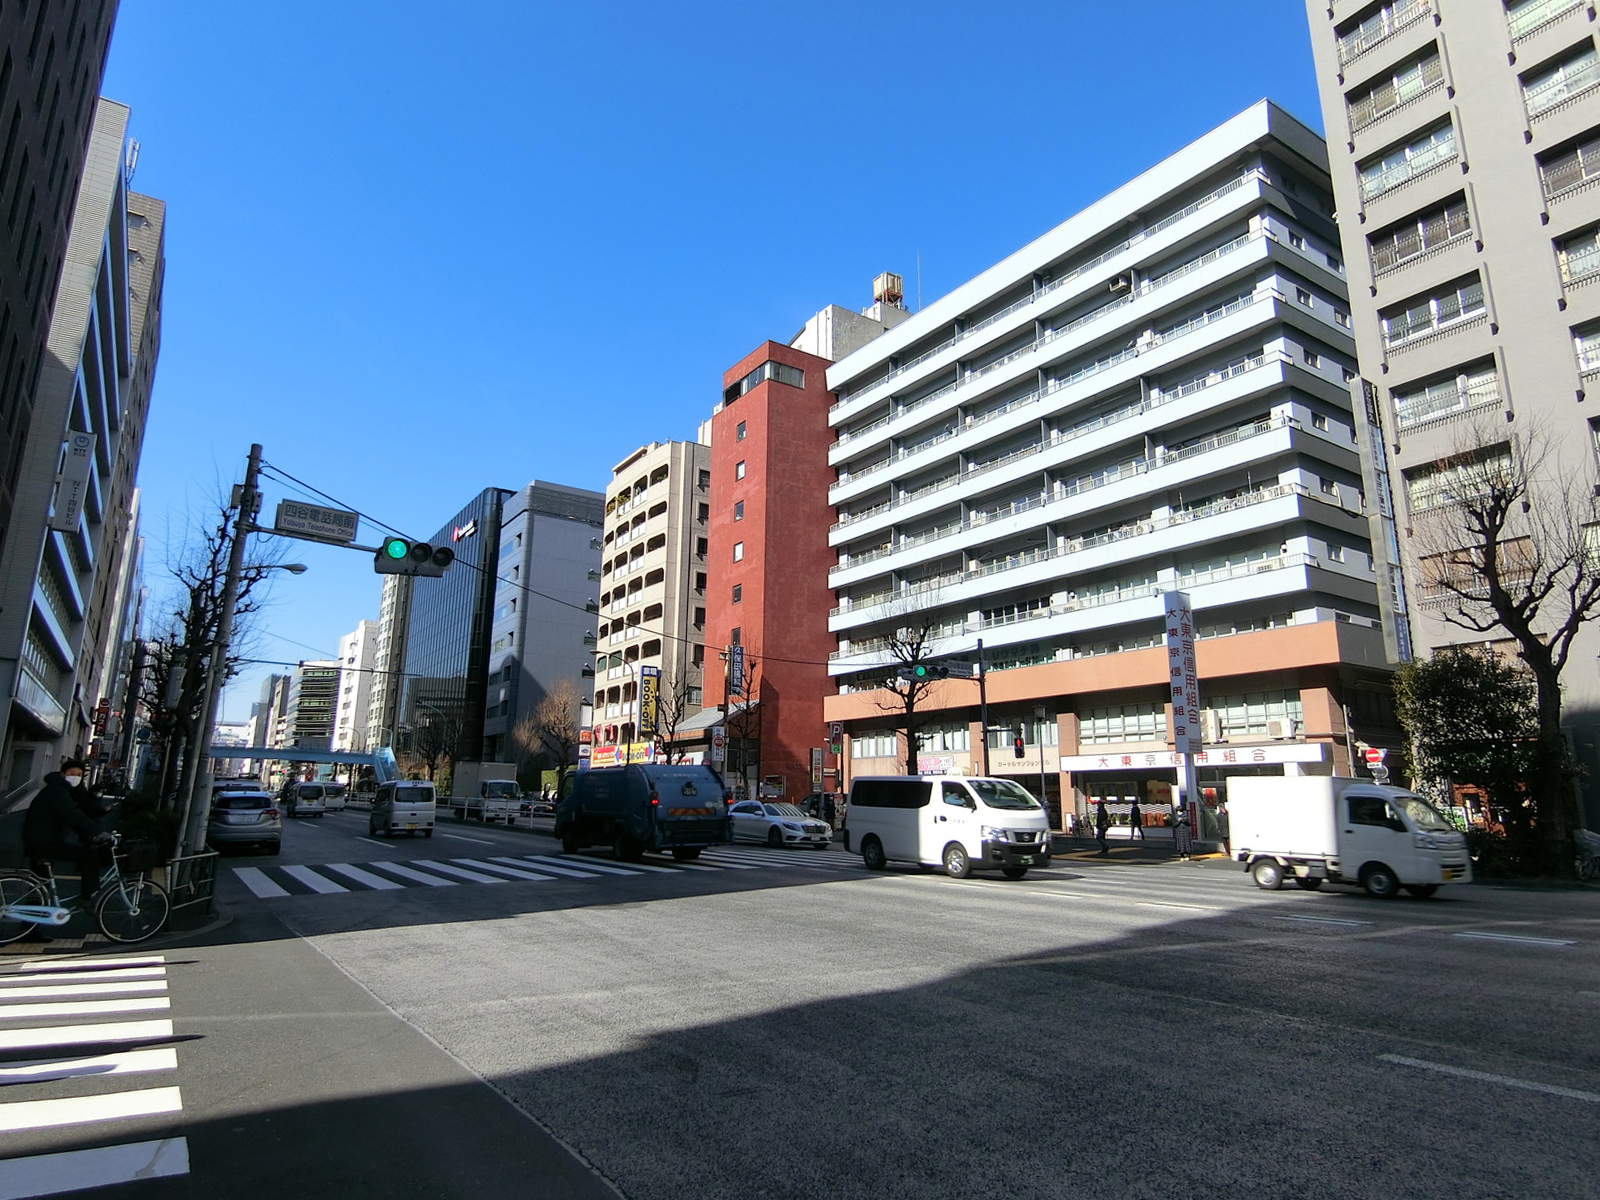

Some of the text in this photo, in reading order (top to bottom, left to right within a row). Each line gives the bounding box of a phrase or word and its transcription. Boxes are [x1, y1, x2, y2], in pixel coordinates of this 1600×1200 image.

[285, 504, 355, 529] 四谷電話局前
[308, 522, 337, 535] Telephone
[337, 528, 354, 538] Office
[1167, 608, 1186, 736] 大東京信用組合
[1179, 606, 1199, 724] 大東京信用組合
[1097, 748, 1266, 769] 大東京信用組合
